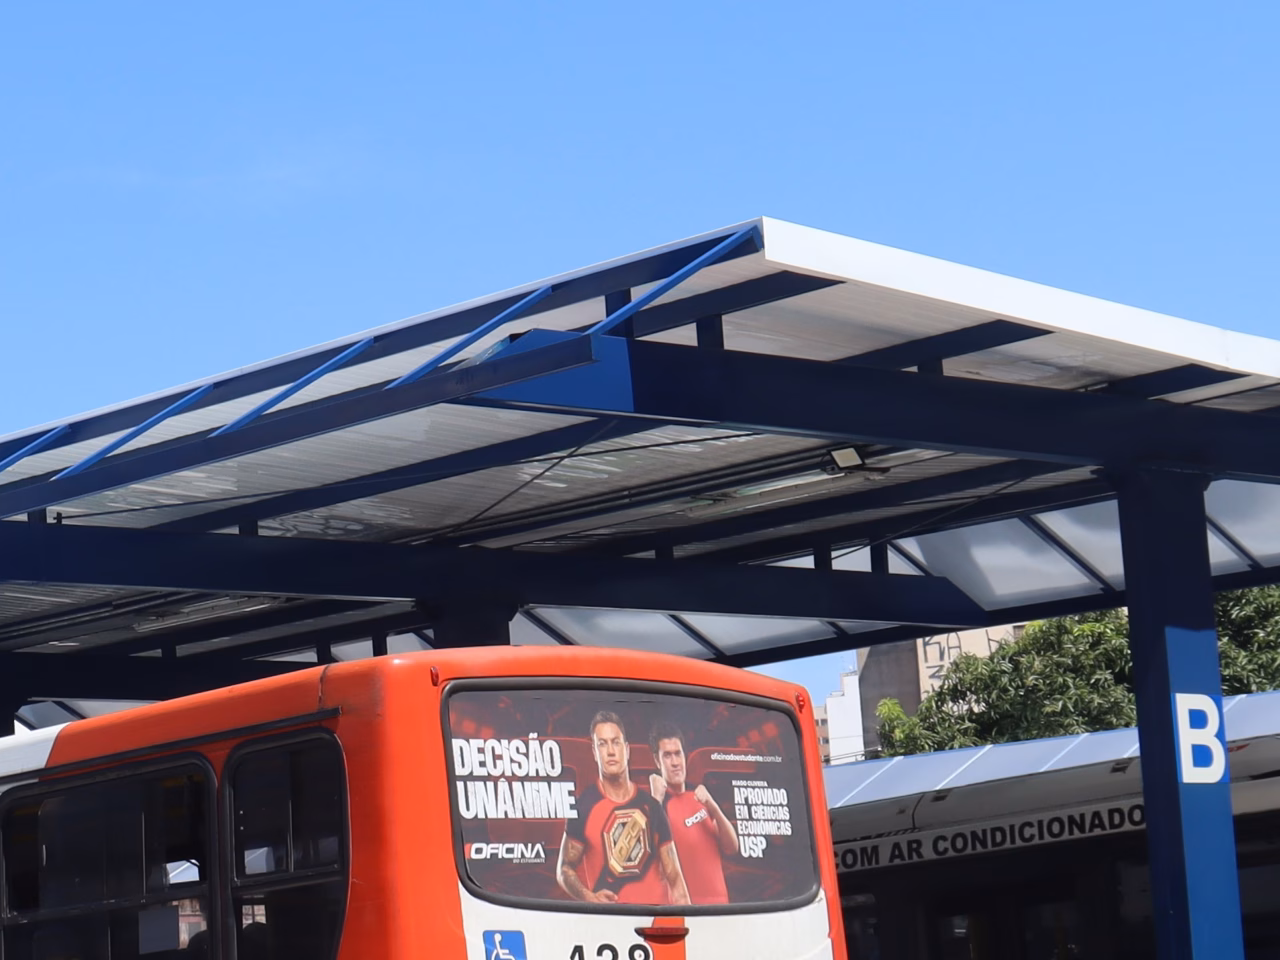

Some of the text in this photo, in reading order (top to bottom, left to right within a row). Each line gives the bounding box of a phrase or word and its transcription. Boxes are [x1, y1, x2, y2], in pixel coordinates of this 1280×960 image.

[1175, 693, 1225, 783] B
[451, 732, 562, 777] DECISÃO
[456, 777, 578, 819] UNÂNIME
[734, 787, 788, 805] APROVADO
[735, 805, 790, 820] EM CIÊNCIAS
[737, 820, 792, 836] ECONÔMICAS
[888, 840, 924, 864] AR
[932, 803, 1146, 857] CONDICIONADO
[470, 842, 545, 859] OFICINA
[739, 836, 767, 858] USP
